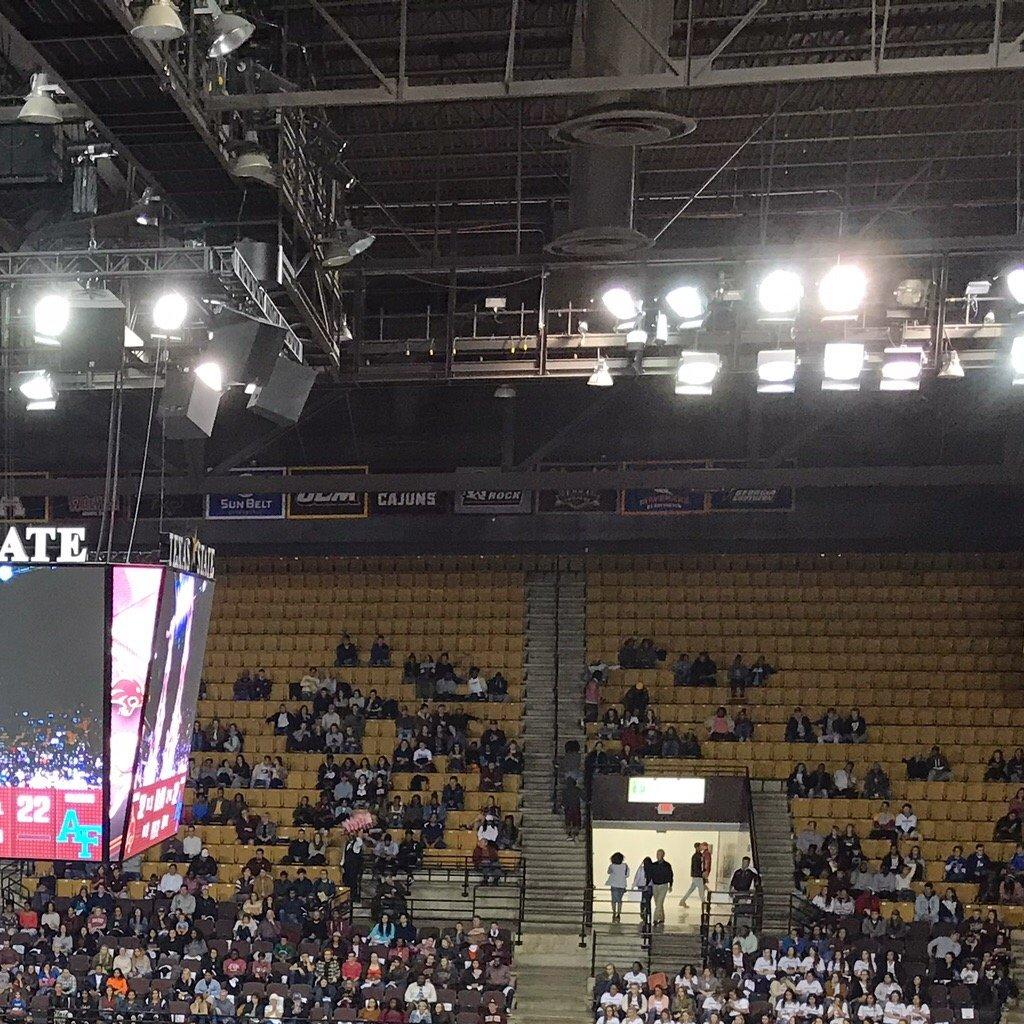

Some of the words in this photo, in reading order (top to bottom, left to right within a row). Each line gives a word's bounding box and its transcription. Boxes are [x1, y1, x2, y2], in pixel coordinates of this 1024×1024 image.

[221, 498, 244, 508] SUN
[246, 498, 272, 508] BELT
[377, 492, 436, 506] CAJUNS
[16, 795, 51, 823] 22
